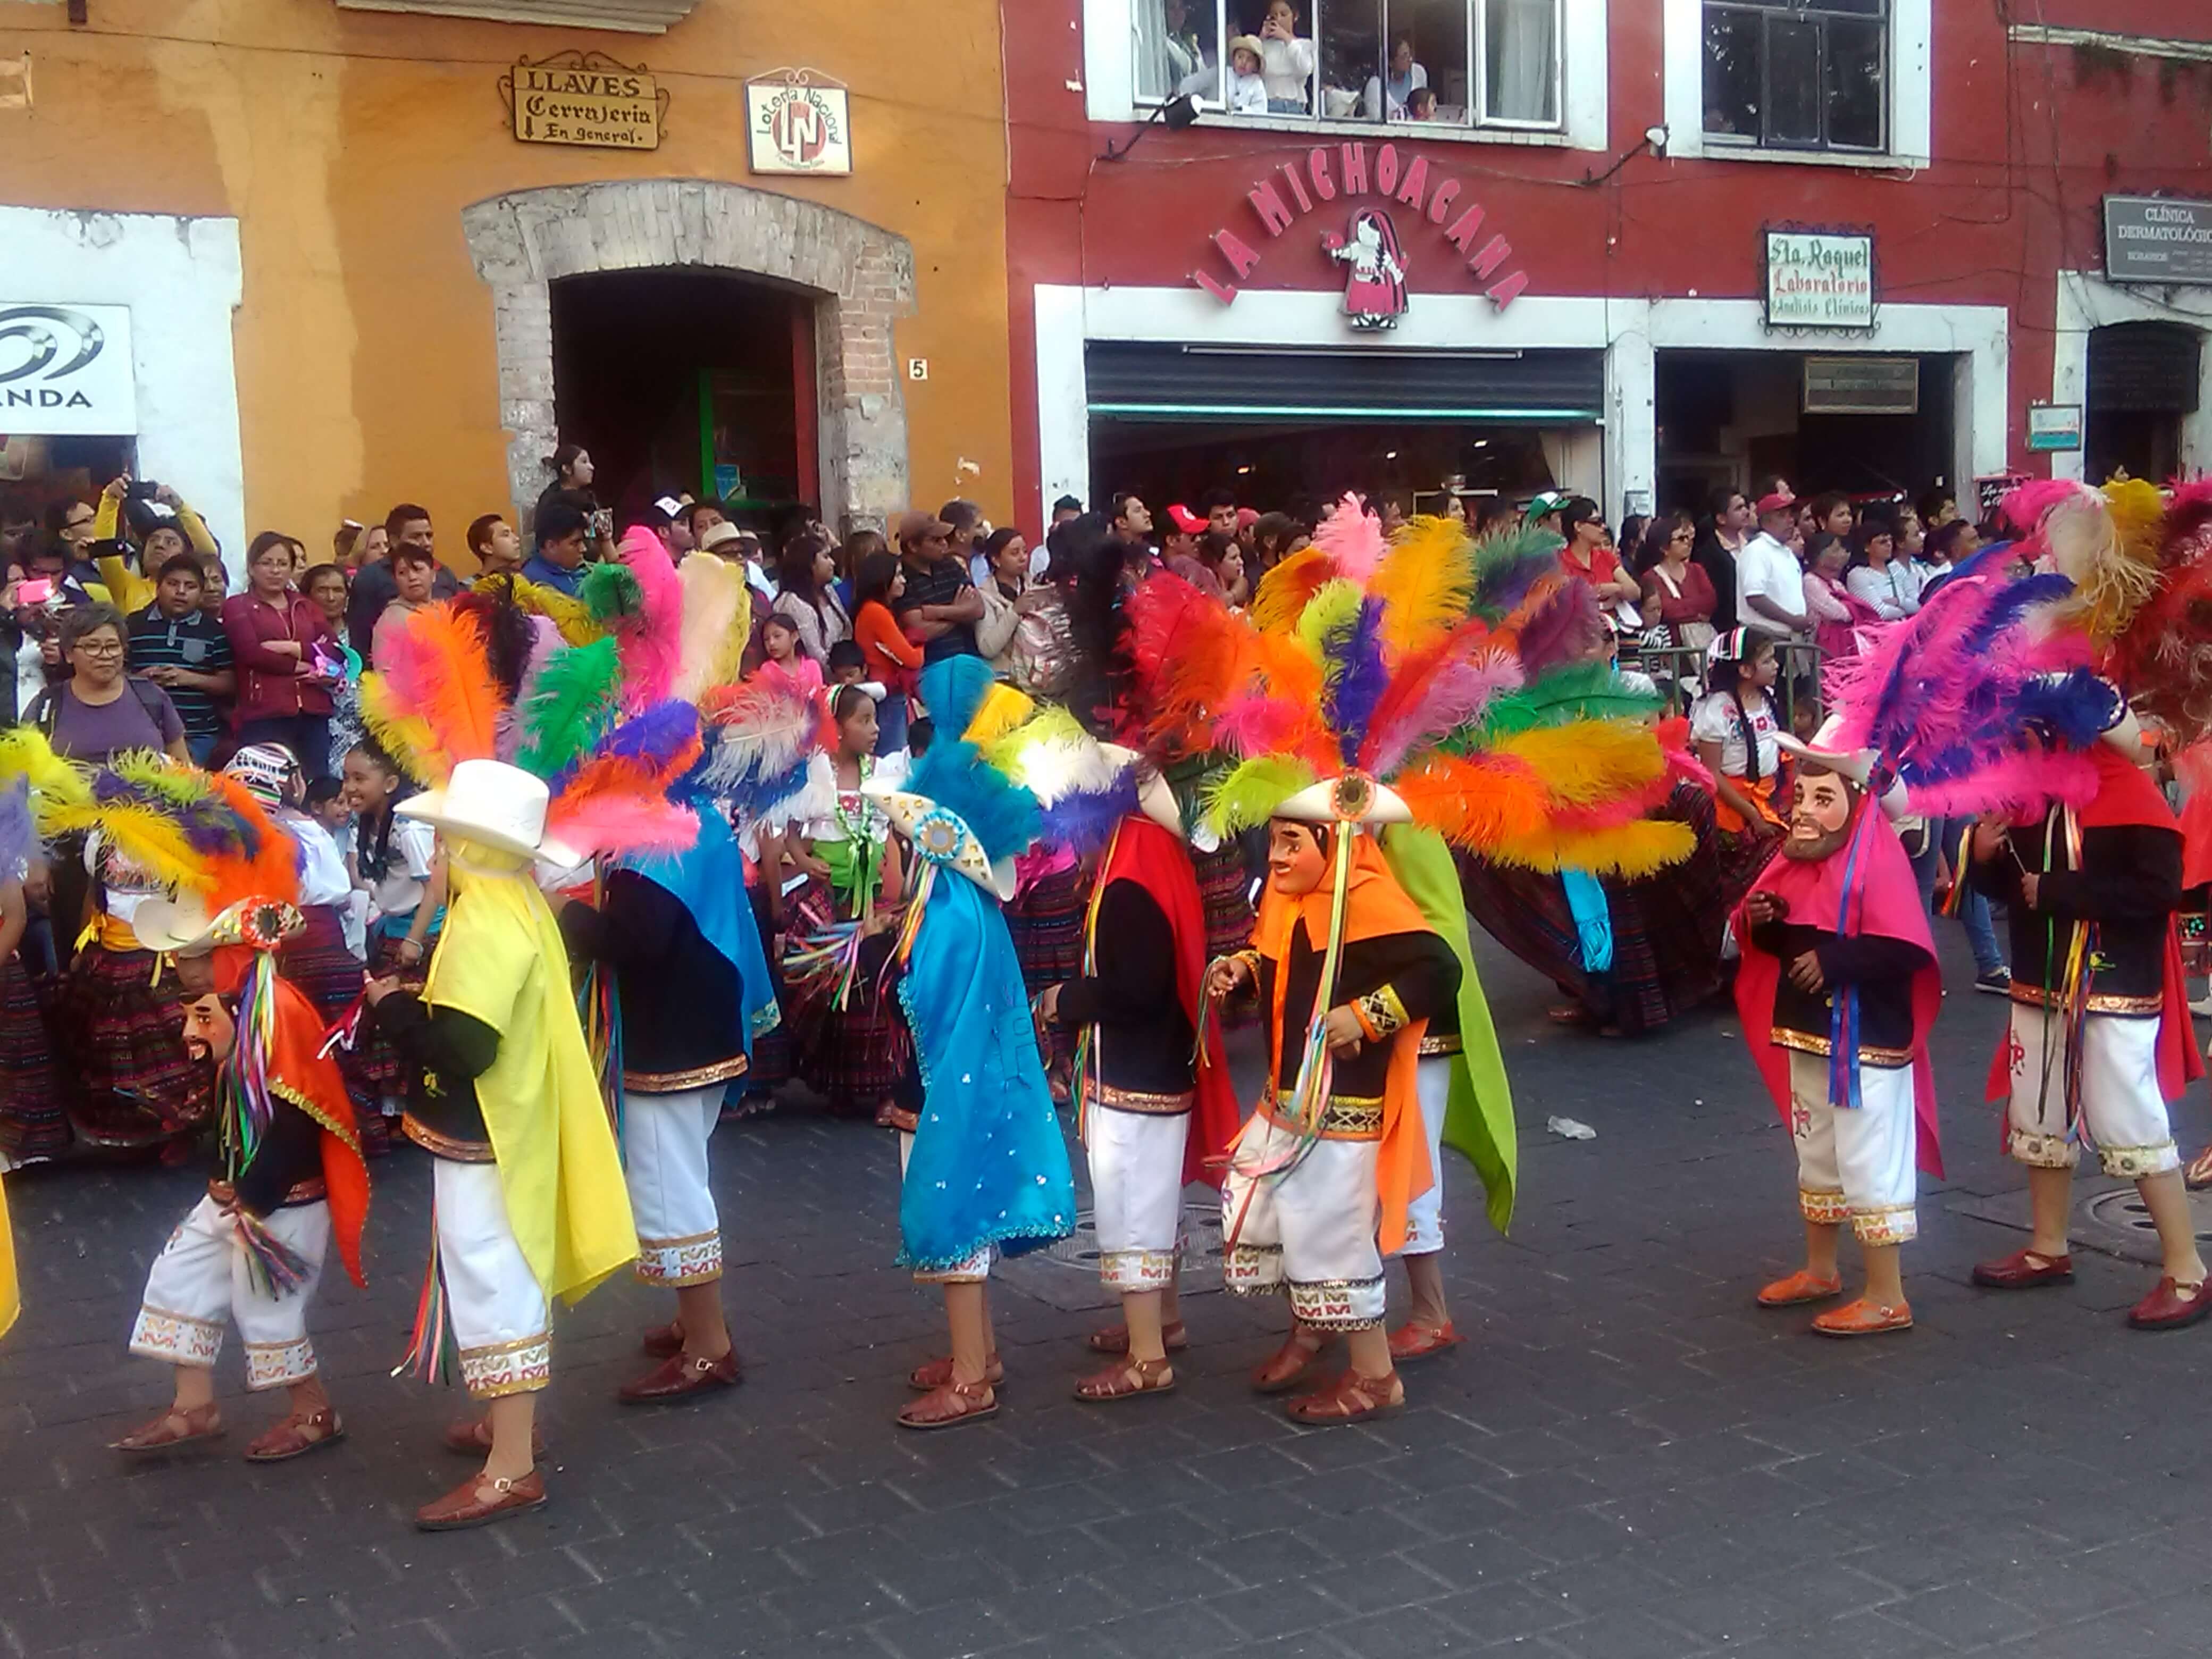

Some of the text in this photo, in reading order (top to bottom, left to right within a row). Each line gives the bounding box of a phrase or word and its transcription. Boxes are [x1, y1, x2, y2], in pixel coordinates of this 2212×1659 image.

[527, 71, 641, 98] LLAVES
[803, 86, 843, 145] Nacional
[543, 122, 569, 139] En
[2145, 204, 2195, 224] CLÍNICA
[1246, 141, 1529, 314] MICHOACANA
[1190, 229, 1261, 307] LA
[1808, 238, 1868, 279] Raquel
[1774, 268, 1867, 293] Laboratorio
[913, 360, 924, 378] 5
[0, 389, 93, 408] NDA
